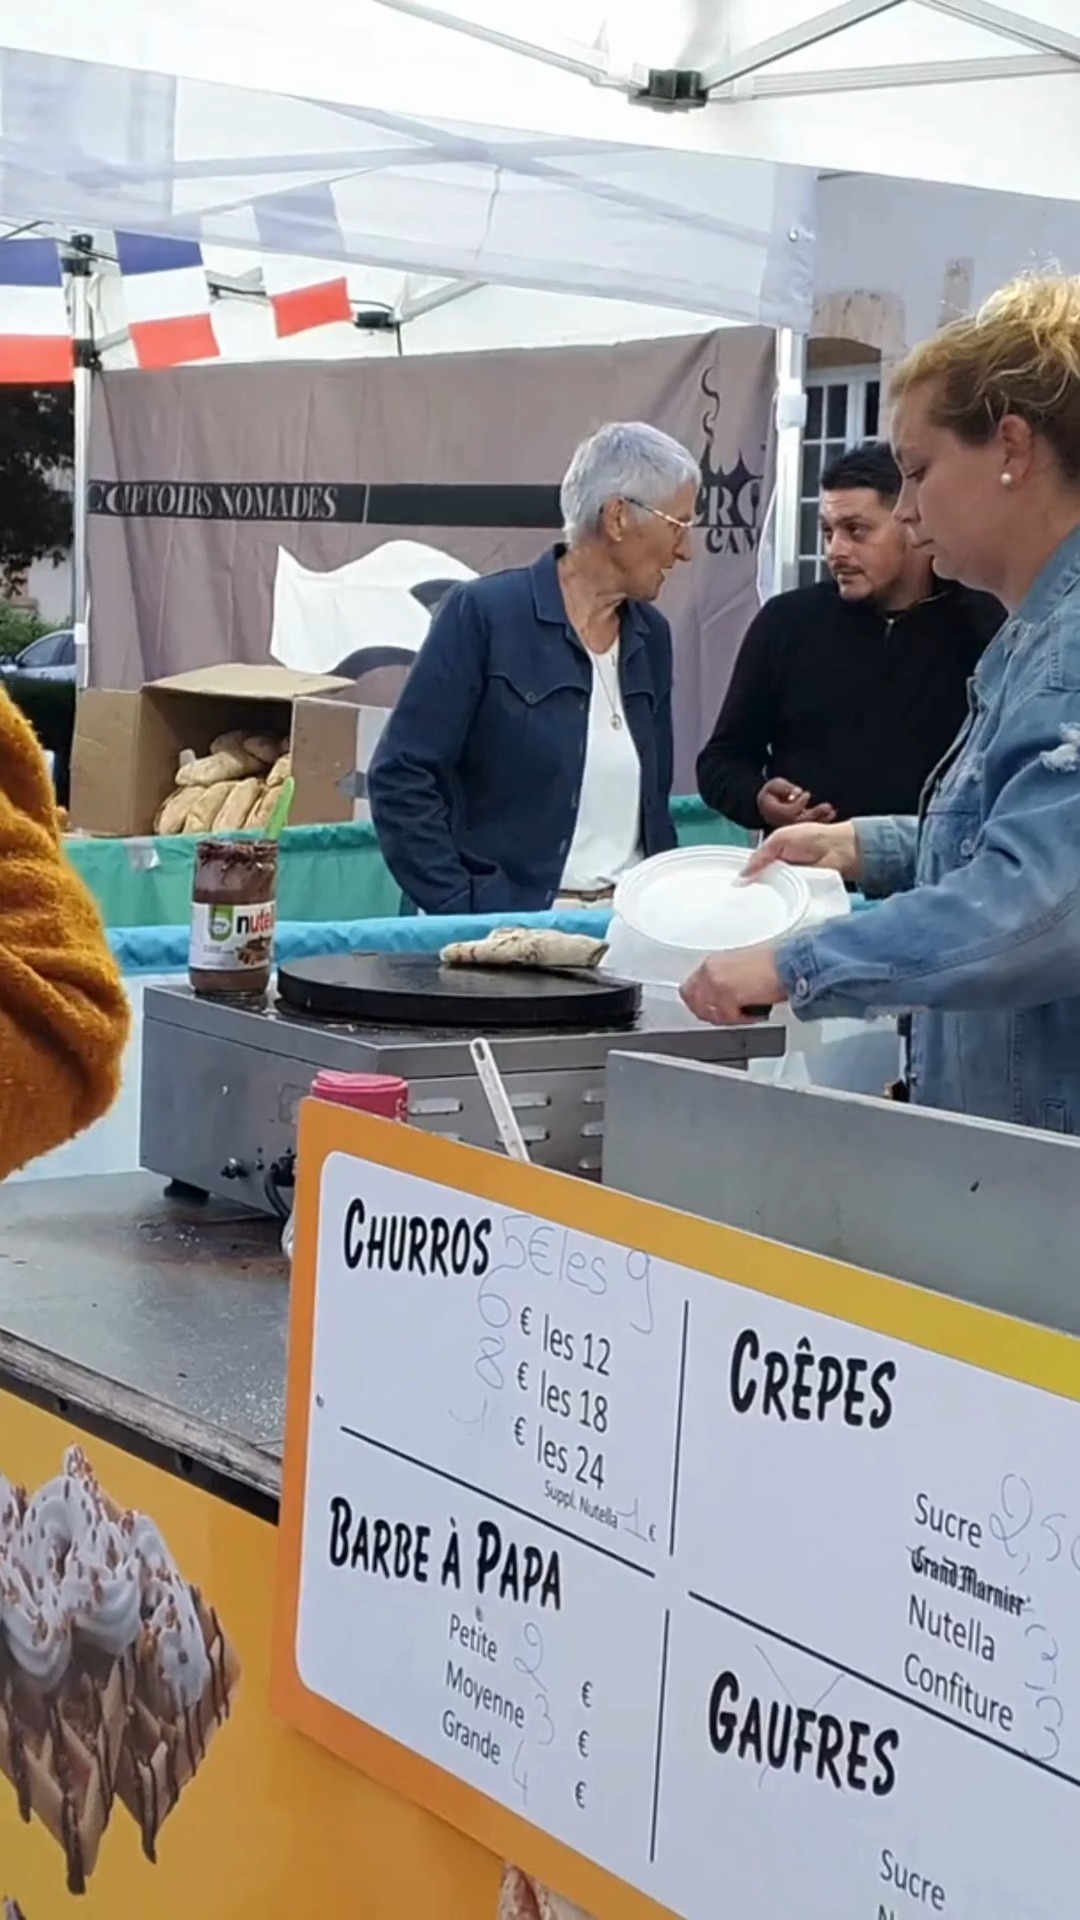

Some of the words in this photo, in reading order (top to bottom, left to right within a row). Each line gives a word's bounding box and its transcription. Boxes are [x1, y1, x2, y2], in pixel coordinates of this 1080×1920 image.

[220, 485, 338, 518] NOMADES
[343, 1197, 492, 1278] CHURROS
[476, 1266, 512, 1329] 6
[520, 1306, 532, 1336] €
[543, 1313, 574, 1361] les
[582, 1332, 611, 1376] 12
[626, 1248, 654, 1335] 9
[474, 1336, 506, 1390] 8
[517, 1361, 529, 1391] €
[540, 1369, 571, 1417] les
[579, 1389, 608, 1433] 18
[730, 1328, 897, 1430] CRÊPES
[514, 1416, 526, 1446] €
[537, 1424, 568, 1473] les
[575, 1445, 605, 1491] 24
[543, 1479, 577, 1510] Suppl.
[579, 1496, 619, 1529] Nutella
[915, 1492, 982, 1549] Sucre
[330, 1496, 431, 1583] BARBE
[441, 1516, 461, 1590] À
[477, 1520, 562, 1612] PAPA
[909, 1545, 958, 1589] Grand
[957, 1565, 1026, 1617] Marnier
[449, 1612, 498, 1662] Petite
[513, 1621, 549, 1693] 2
[580, 1680, 593, 1709] €
[909, 1593, 995, 1662] Nutella
[445, 1660, 526, 1729] Moyenne
[534, 1693, 555, 1746] 3
[577, 1730, 589, 1759] €
[708, 1670, 900, 1797] GAUFRES
[903, 1652, 1014, 1733] Confiture
[442, 1709, 502, 1765] Grande
[511, 1739, 529, 1806] 4
[574, 1780, 587, 1809] €
[880, 1848, 946, 1912] Sucre
